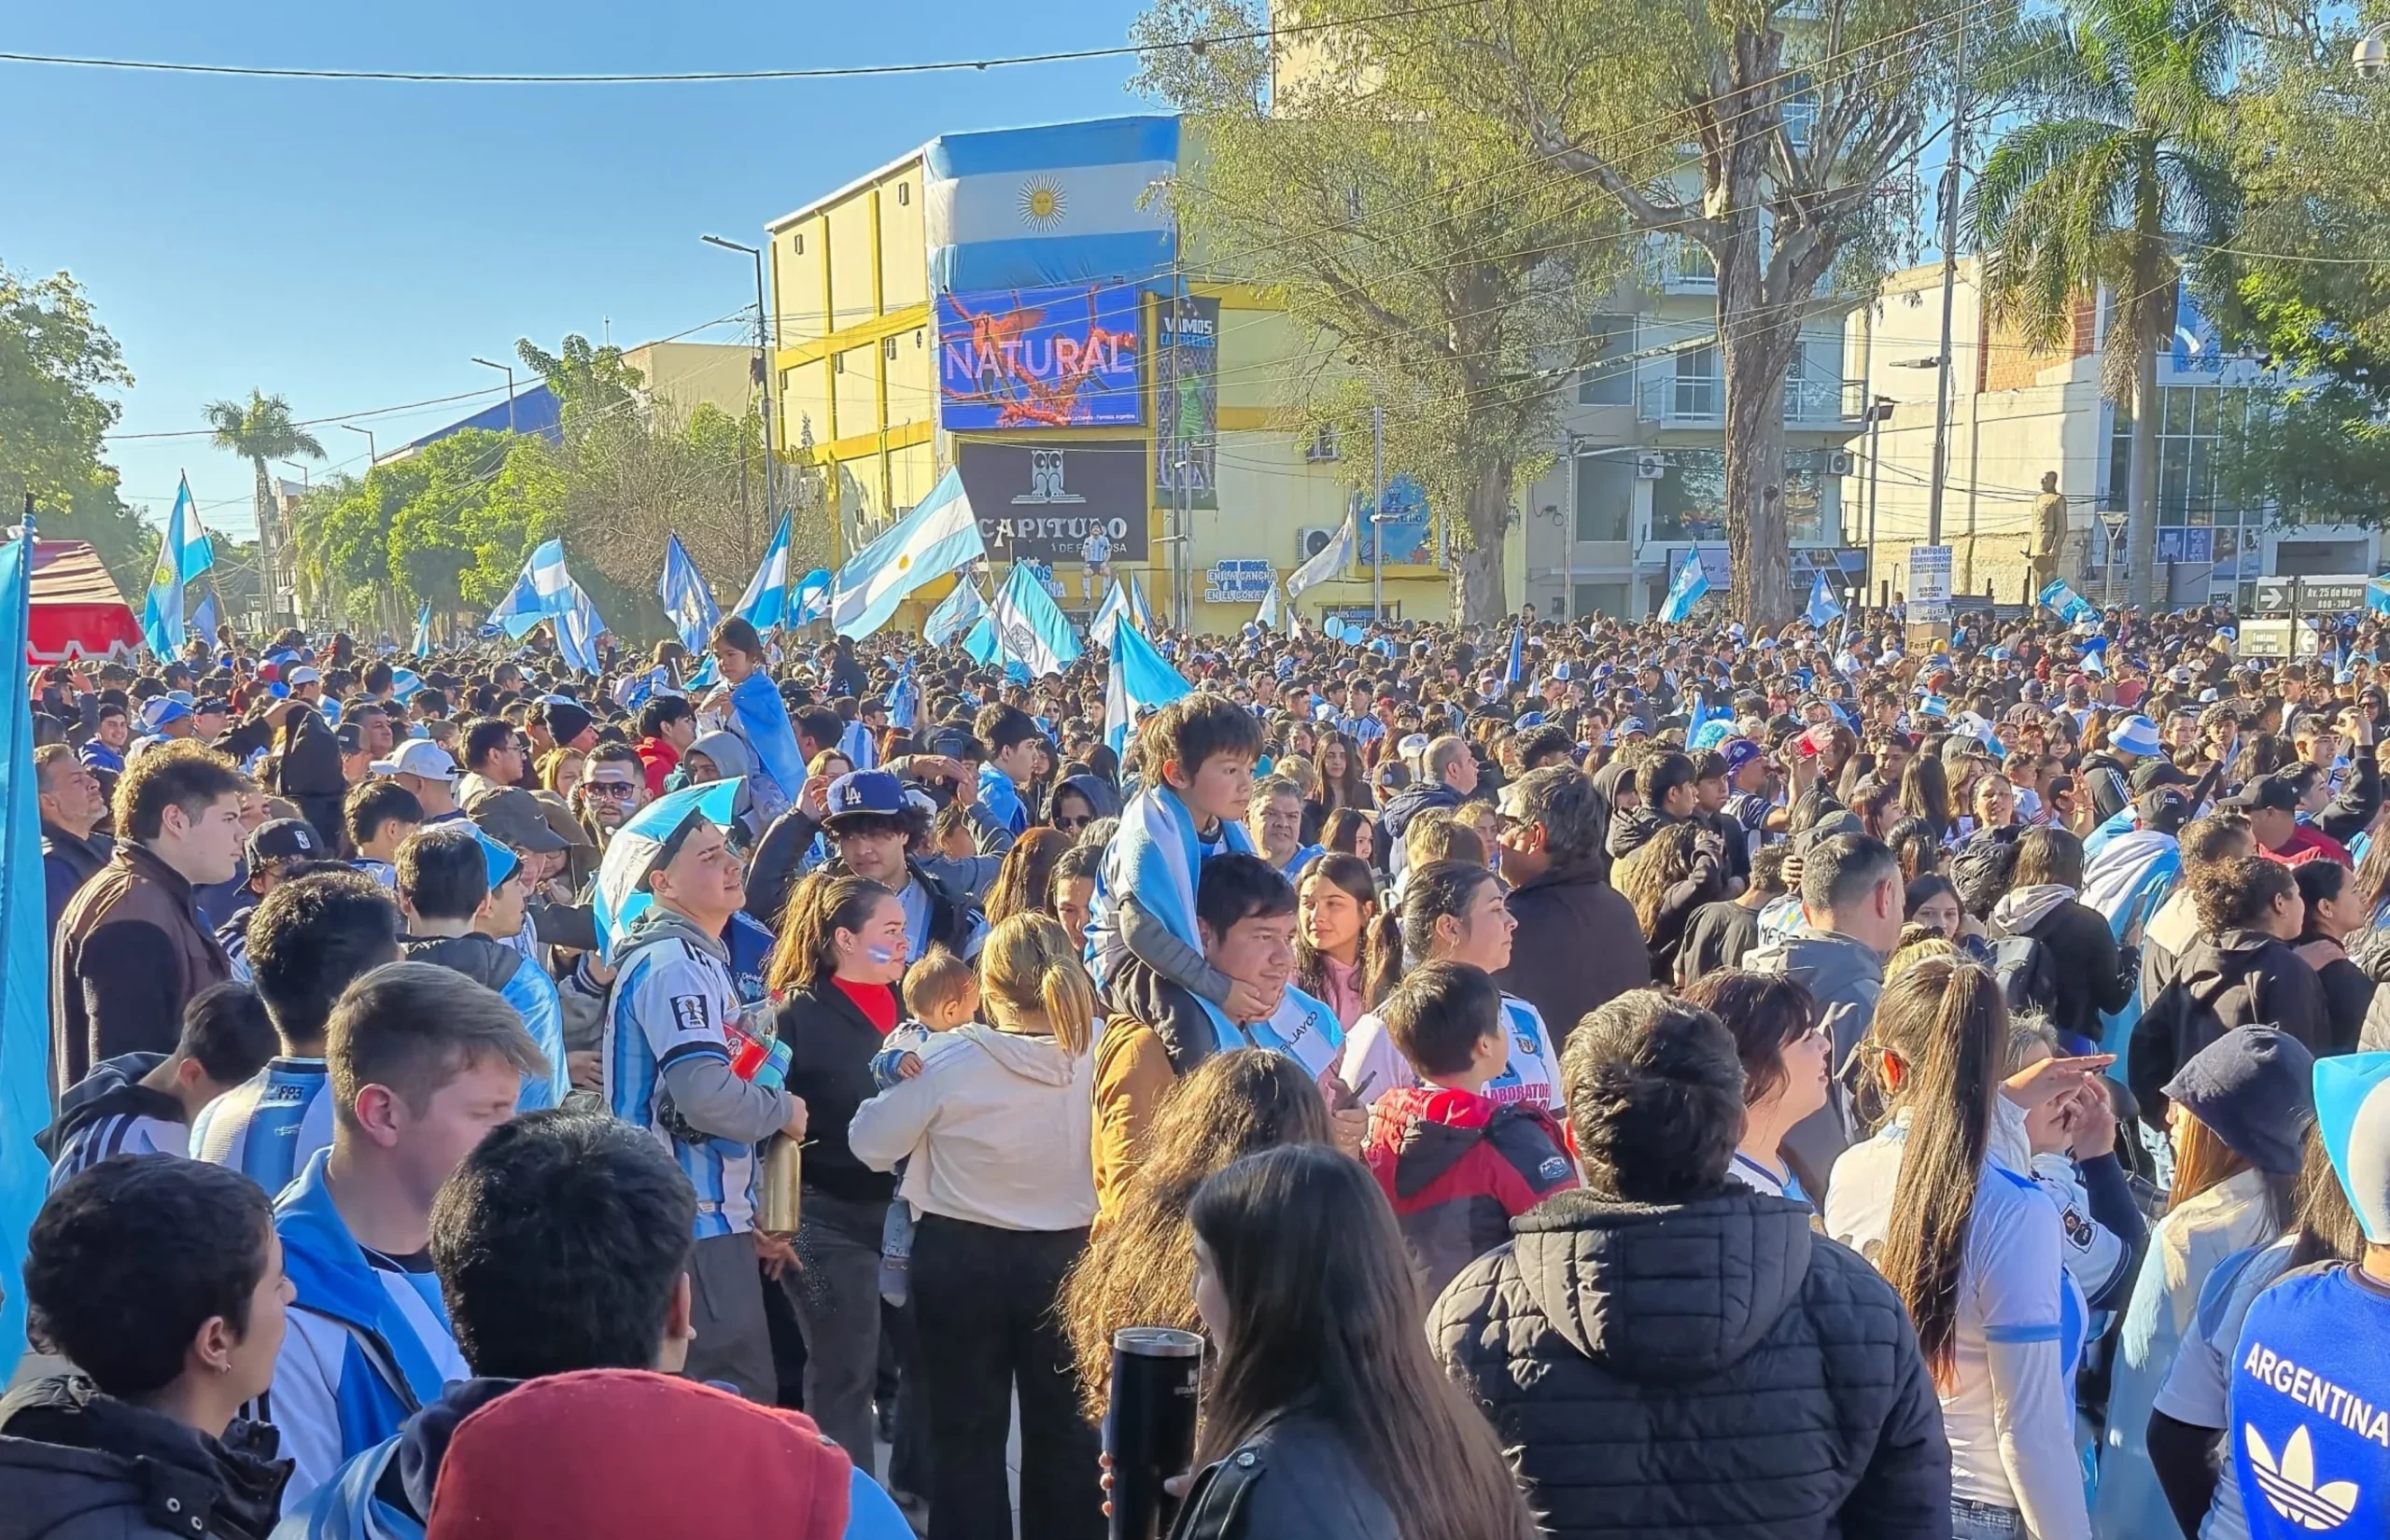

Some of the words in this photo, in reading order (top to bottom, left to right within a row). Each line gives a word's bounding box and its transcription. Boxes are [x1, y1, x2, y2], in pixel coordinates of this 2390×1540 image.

[945, 335, 1134, 381] NATURAL
[1059, 542, 1074, 553] DE
[1920, 547, 1953, 555] MODELO
[1239, 570, 1276, 581] CANCHA
[1236, 590, 1280, 600] CORAZ
[2307, 587, 2318, 598] Av.
[2318, 587, 2329, 597] 25
[2330, 586, 2341, 597] de
[2341, 586, 2363, 598] Mayo
[843, 783, 862, 805] LA
[2243, 1341, 2389, 1449] ARGENTINA
